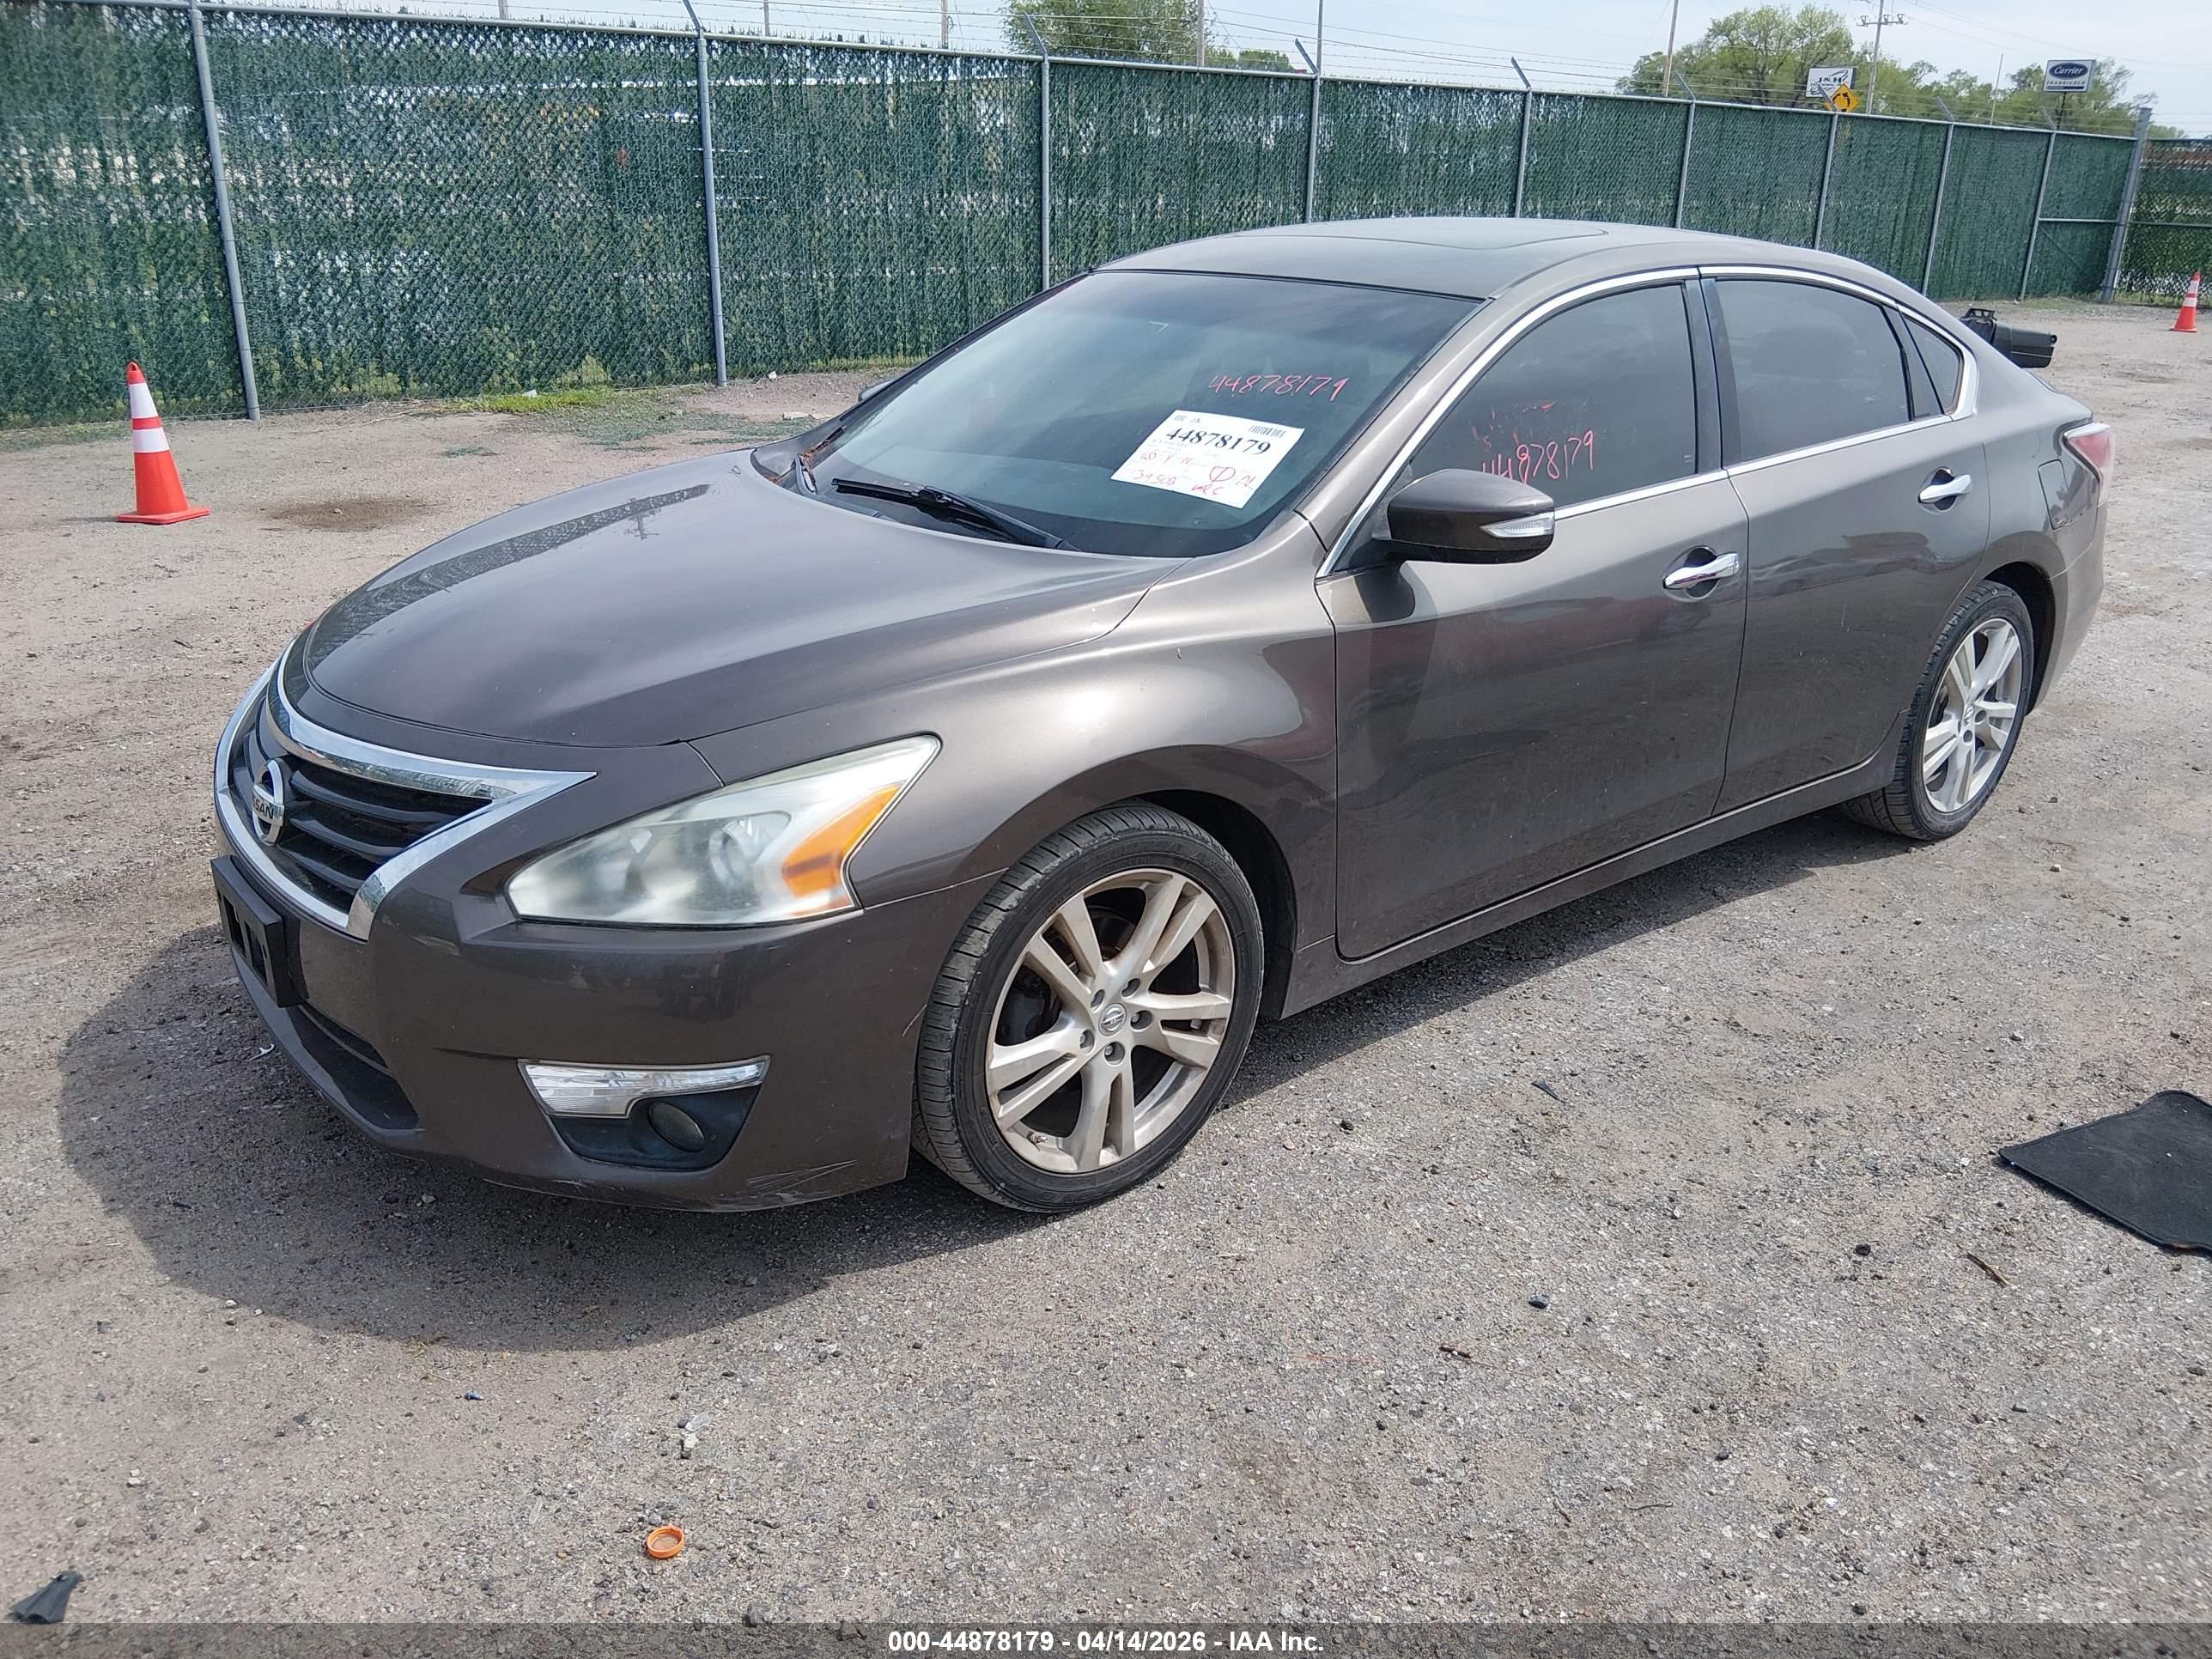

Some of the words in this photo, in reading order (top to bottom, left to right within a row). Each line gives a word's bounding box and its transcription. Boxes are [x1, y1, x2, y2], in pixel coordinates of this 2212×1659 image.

[2054, 66, 2083, 75] Carrier
[1208, 374, 1350, 402] 44878179
[1166, 428, 1271, 455] 44878179
